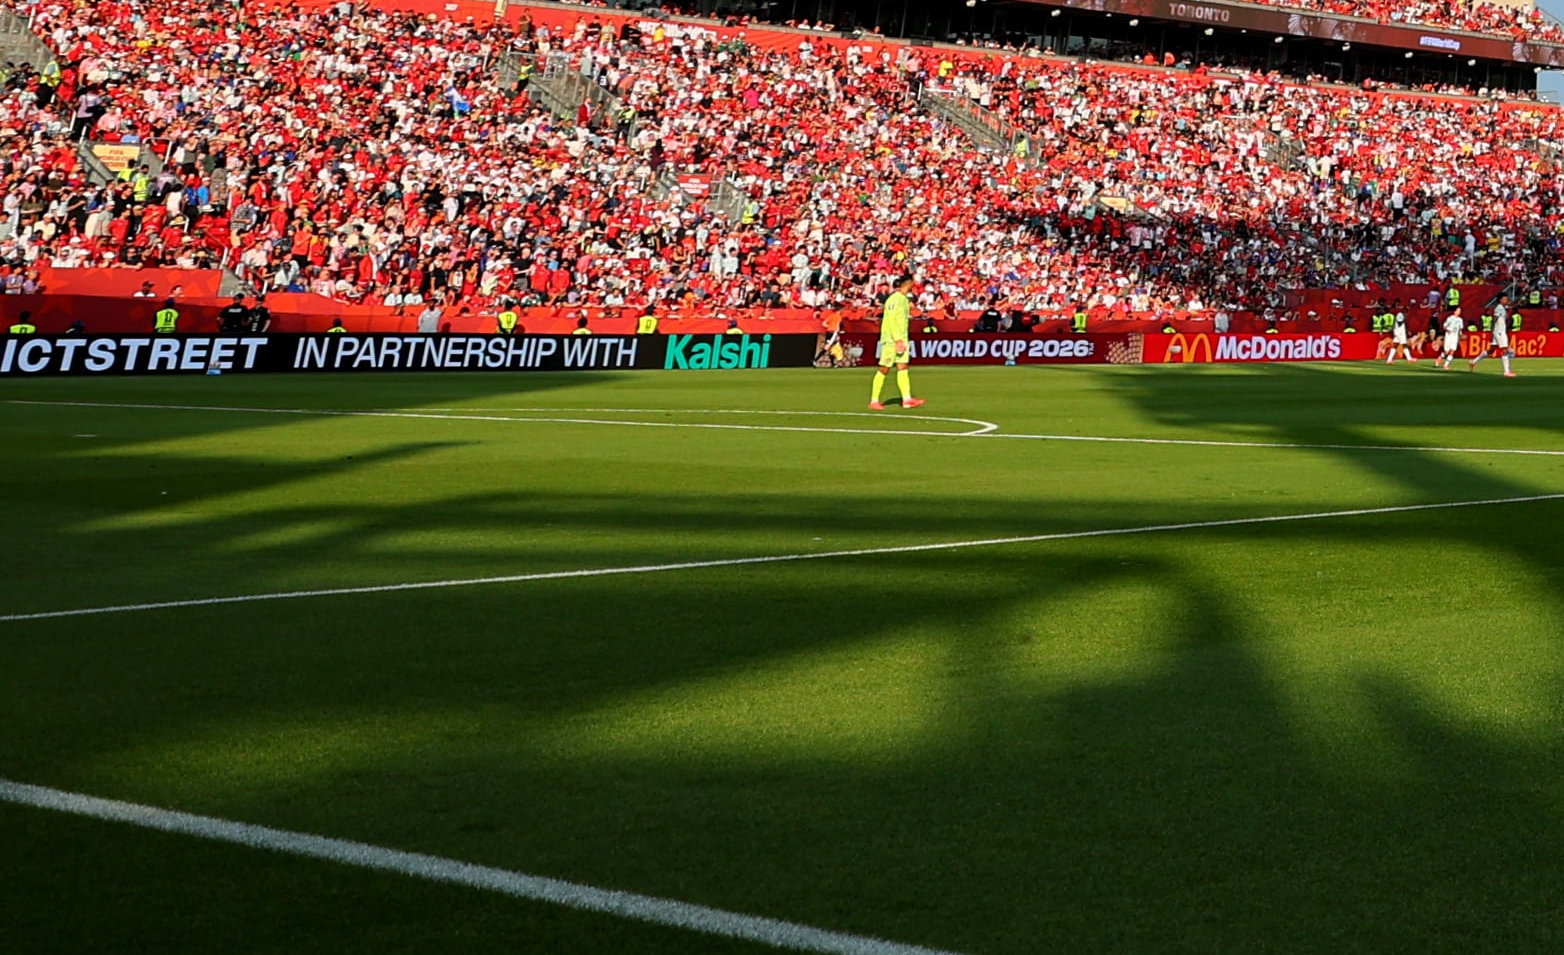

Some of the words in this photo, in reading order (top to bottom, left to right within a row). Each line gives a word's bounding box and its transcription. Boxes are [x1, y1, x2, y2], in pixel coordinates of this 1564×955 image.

[1169, 3, 1230, 22] TORONTO
[0, 337, 268, 372] ICTSTREET
[294, 337, 331, 369] IN
[334, 336, 557, 368] PARTNERSHIP
[563, 337, 638, 368] WITH
[664, 334, 772, 370] Kalshi
[921, 339, 988, 358] WORLD
[990, 339, 1027, 358] CUP
[1028, 339, 1090, 358] 2026
[1215, 334, 1341, 360] McDonald's
